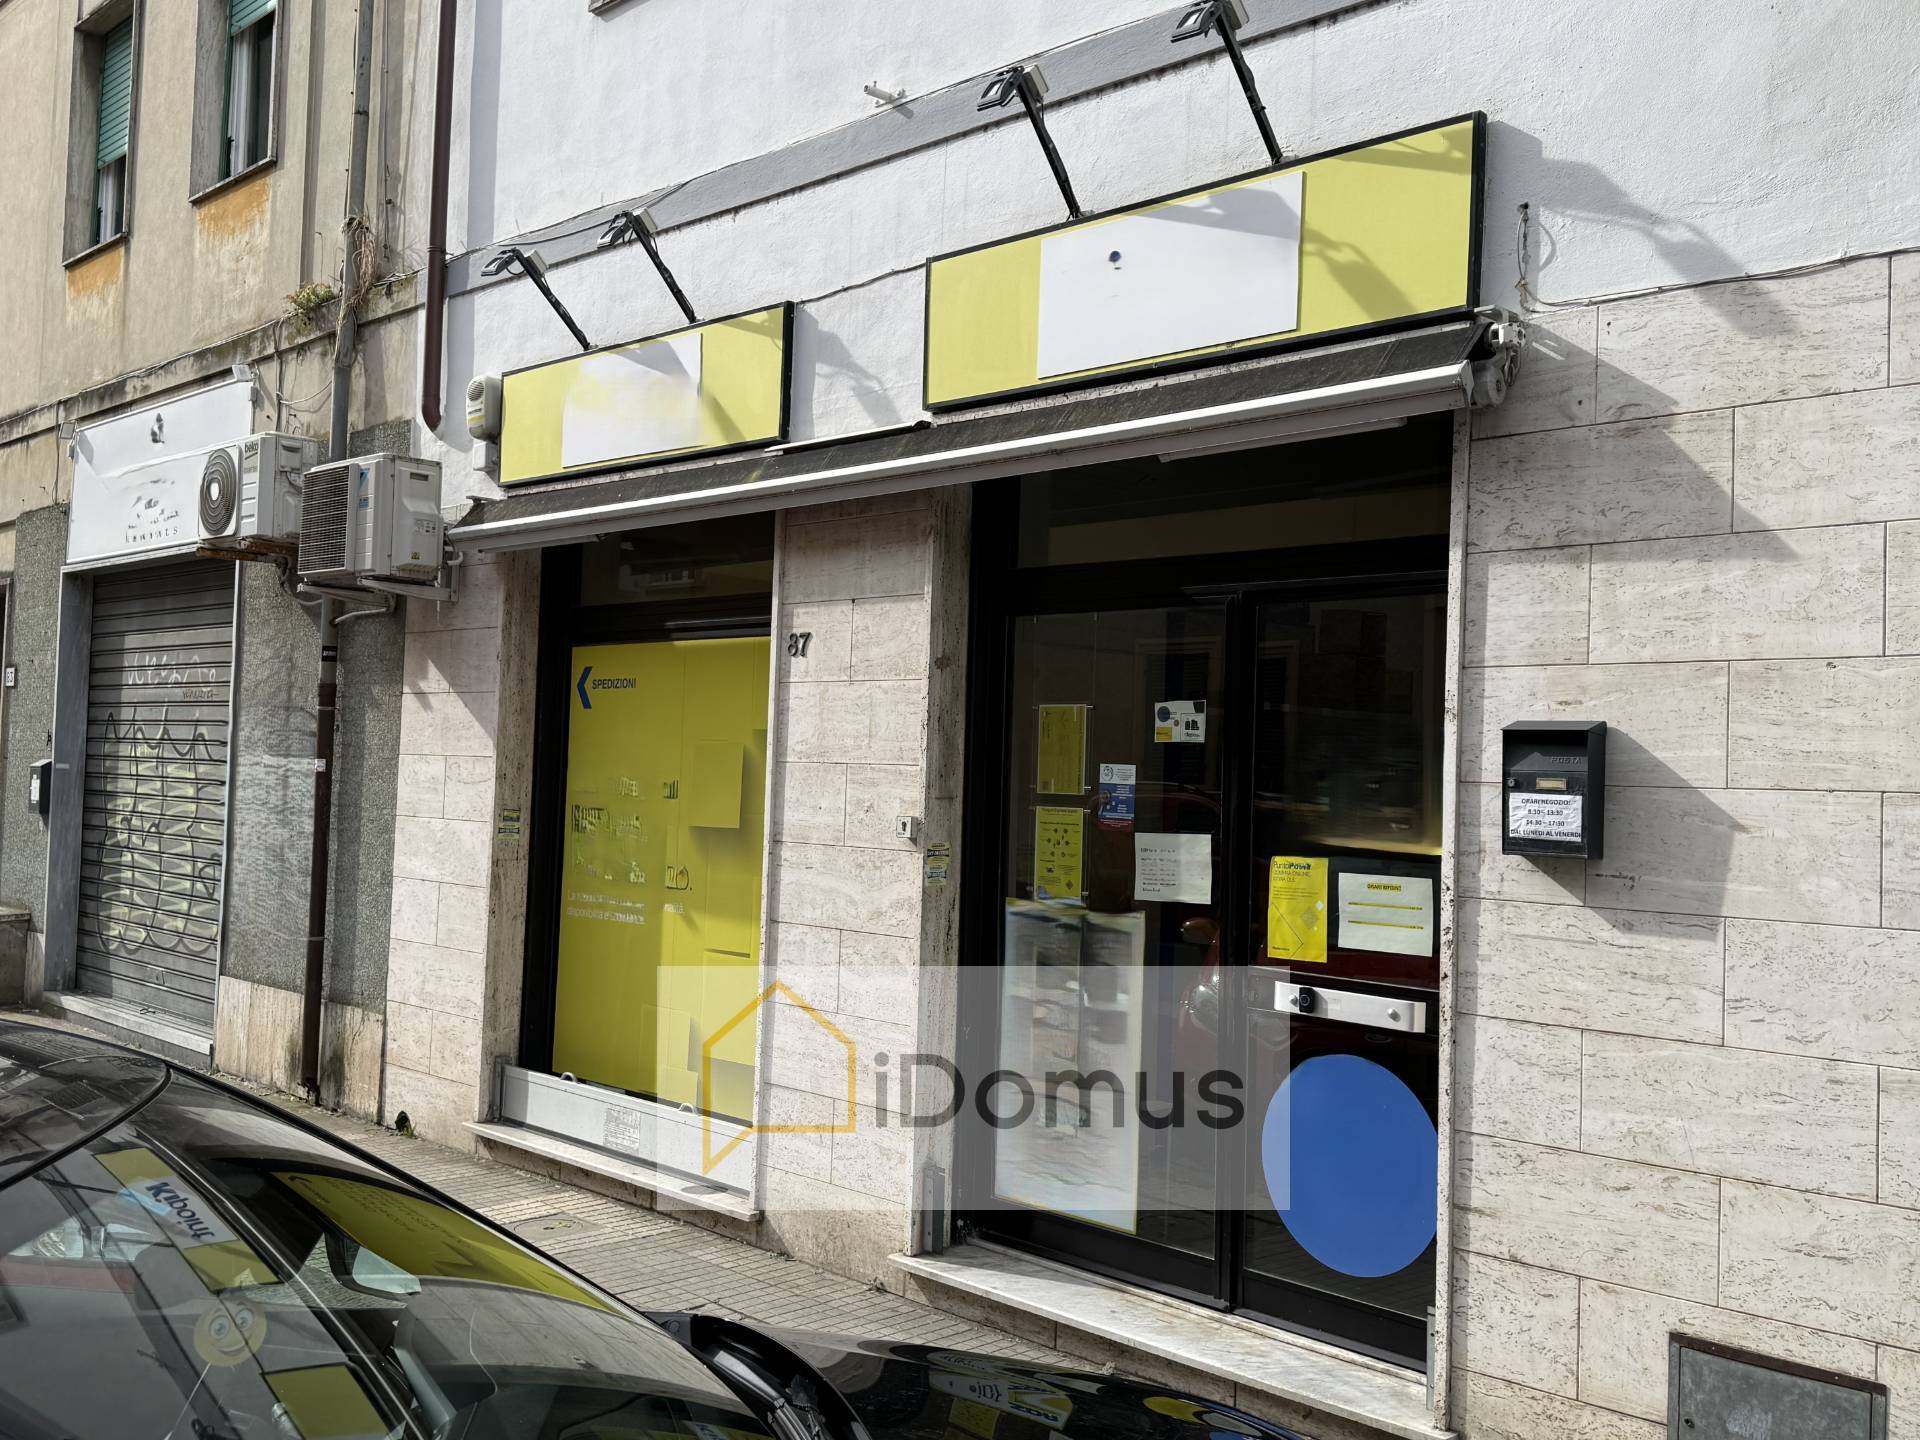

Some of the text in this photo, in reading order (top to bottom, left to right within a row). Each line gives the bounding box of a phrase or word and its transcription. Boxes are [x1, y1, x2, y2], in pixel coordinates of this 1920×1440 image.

[244, 442, 258, 453] beko
[788, 632, 812, 657] 87
[592, 678, 636, 689] SPEDIZIONI
[1551, 756, 1582, 765] POSTA
